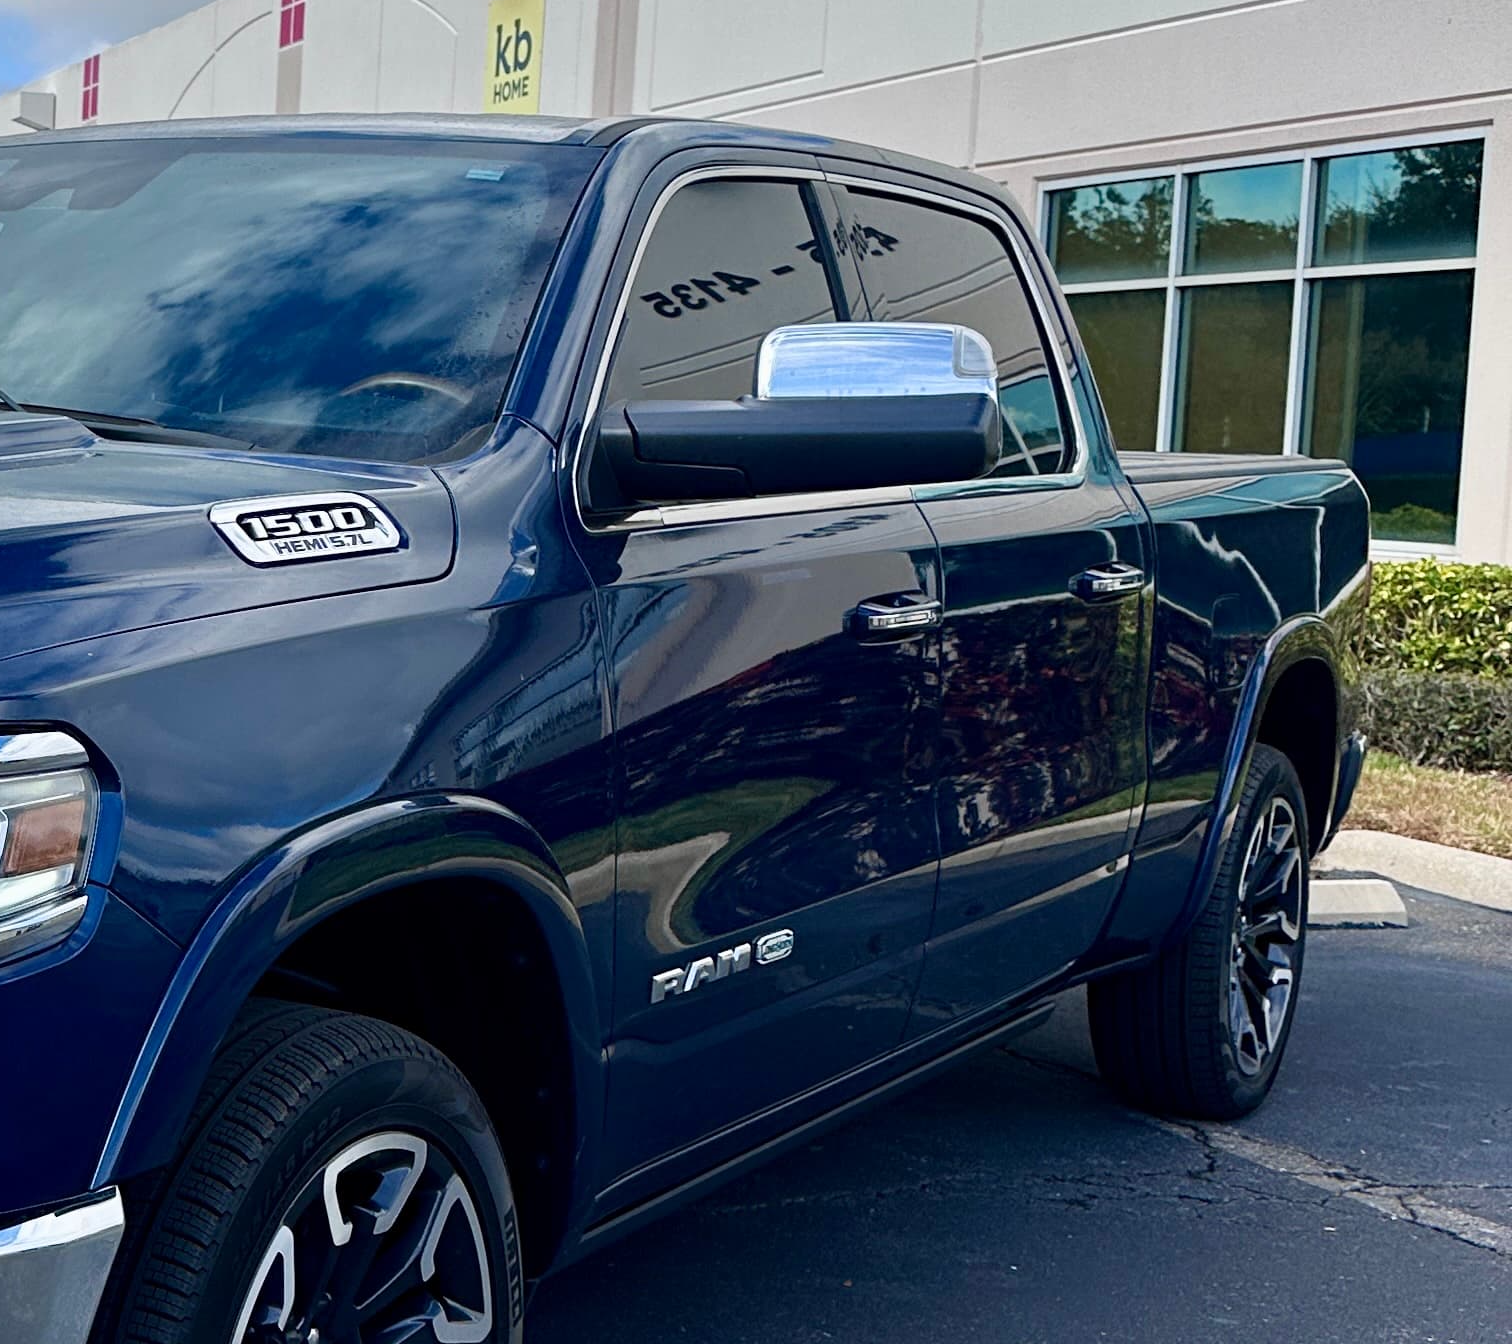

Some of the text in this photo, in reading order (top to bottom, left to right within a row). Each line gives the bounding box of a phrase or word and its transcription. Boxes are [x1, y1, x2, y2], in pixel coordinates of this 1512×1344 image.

[495, 18, 532, 77] kb
[493, 76, 529, 104] HOME
[241, 507, 367, 539] 1500
[274, 533, 373, 554] HEMI 5.7L
[651, 942, 751, 1004] RAM
